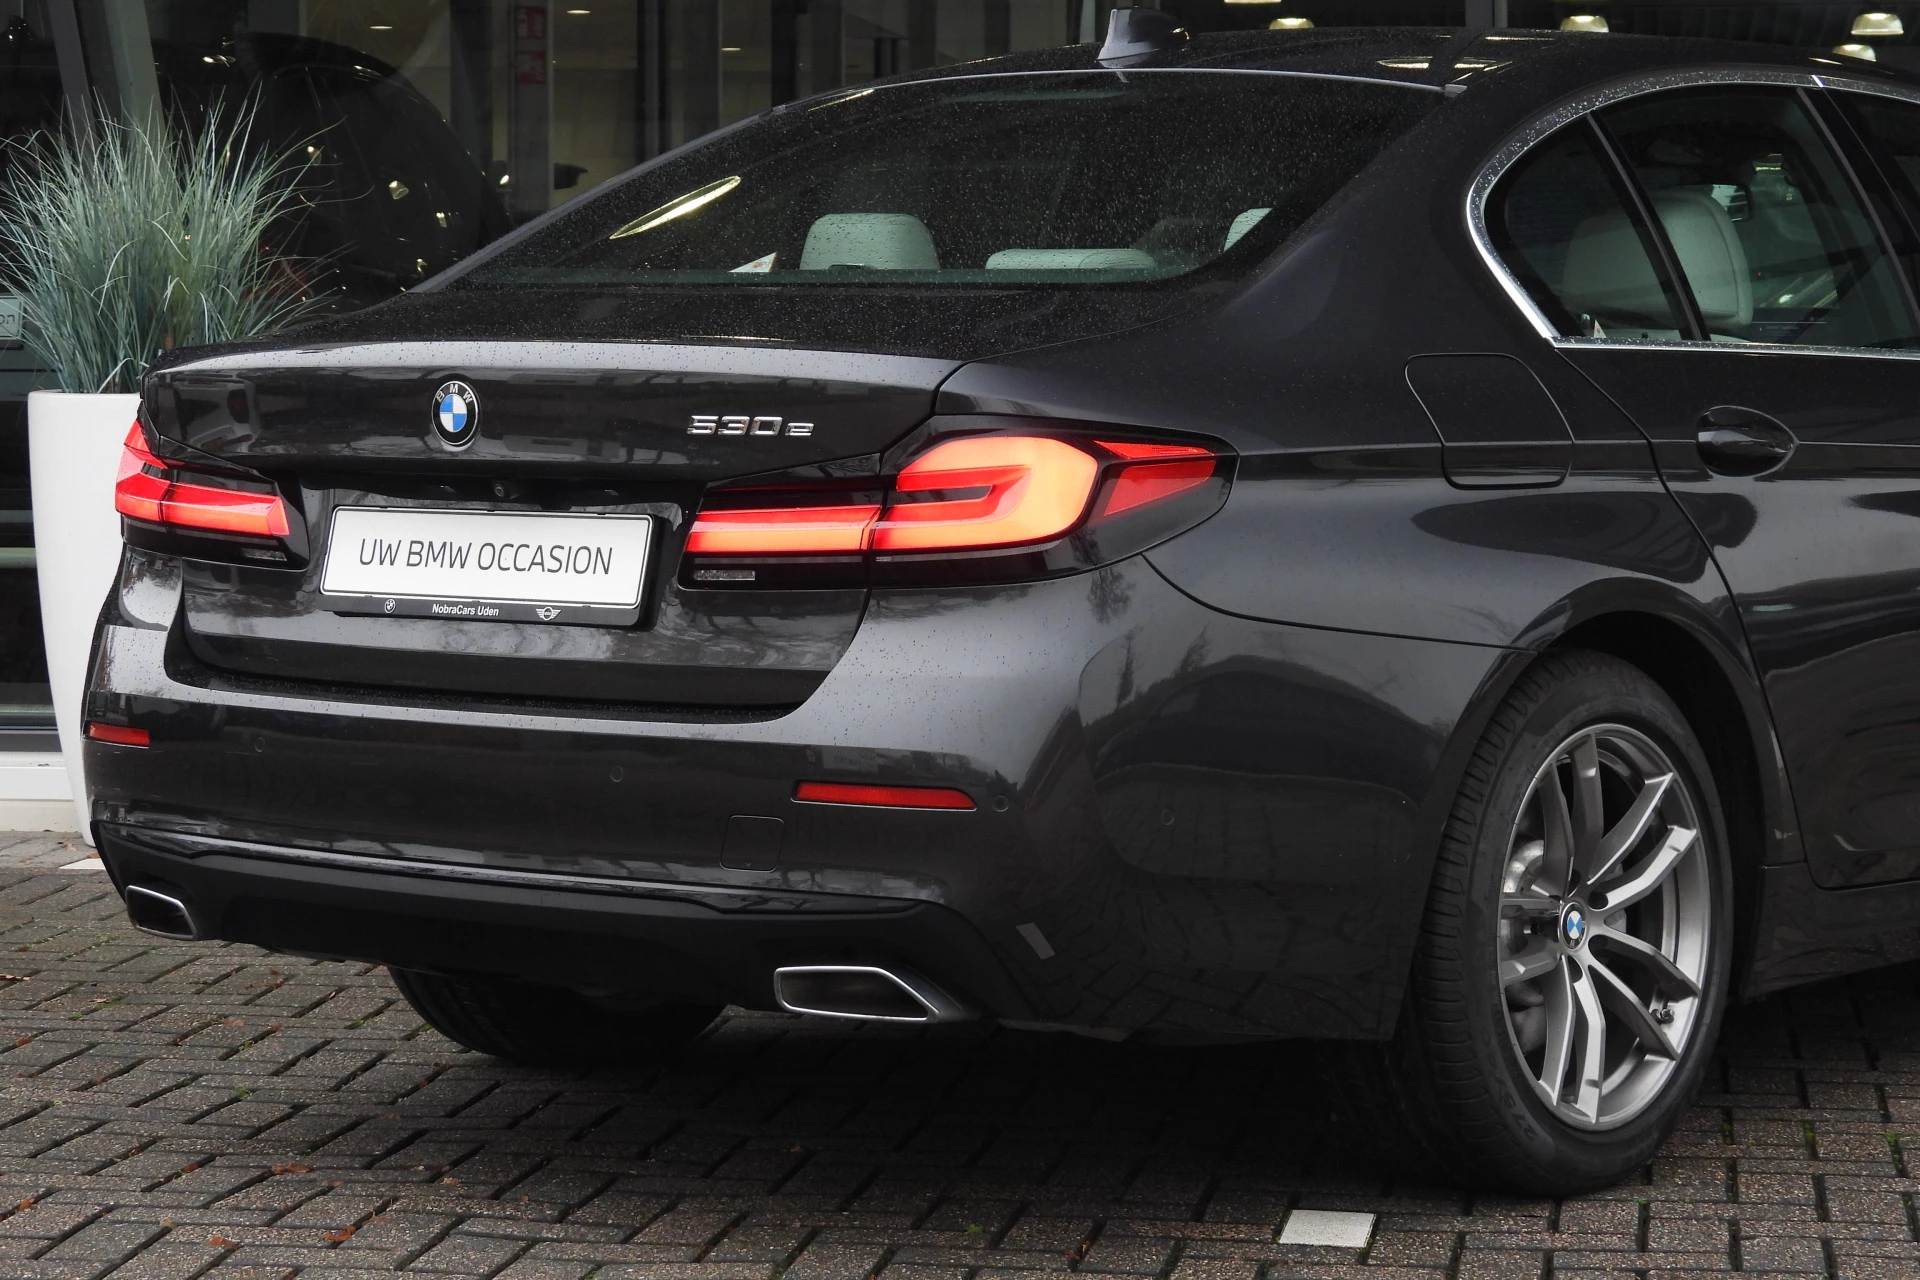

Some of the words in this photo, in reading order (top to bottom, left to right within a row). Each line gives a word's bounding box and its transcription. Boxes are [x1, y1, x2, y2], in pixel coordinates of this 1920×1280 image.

[436, 383, 473, 404] BMW
[359, 538, 402, 566] UW
[406, 540, 473, 569] BMW
[477, 542, 613, 575] OCCASION
[432, 603, 476, 615] NobraCars
[477, 605, 500, 617] Uden
